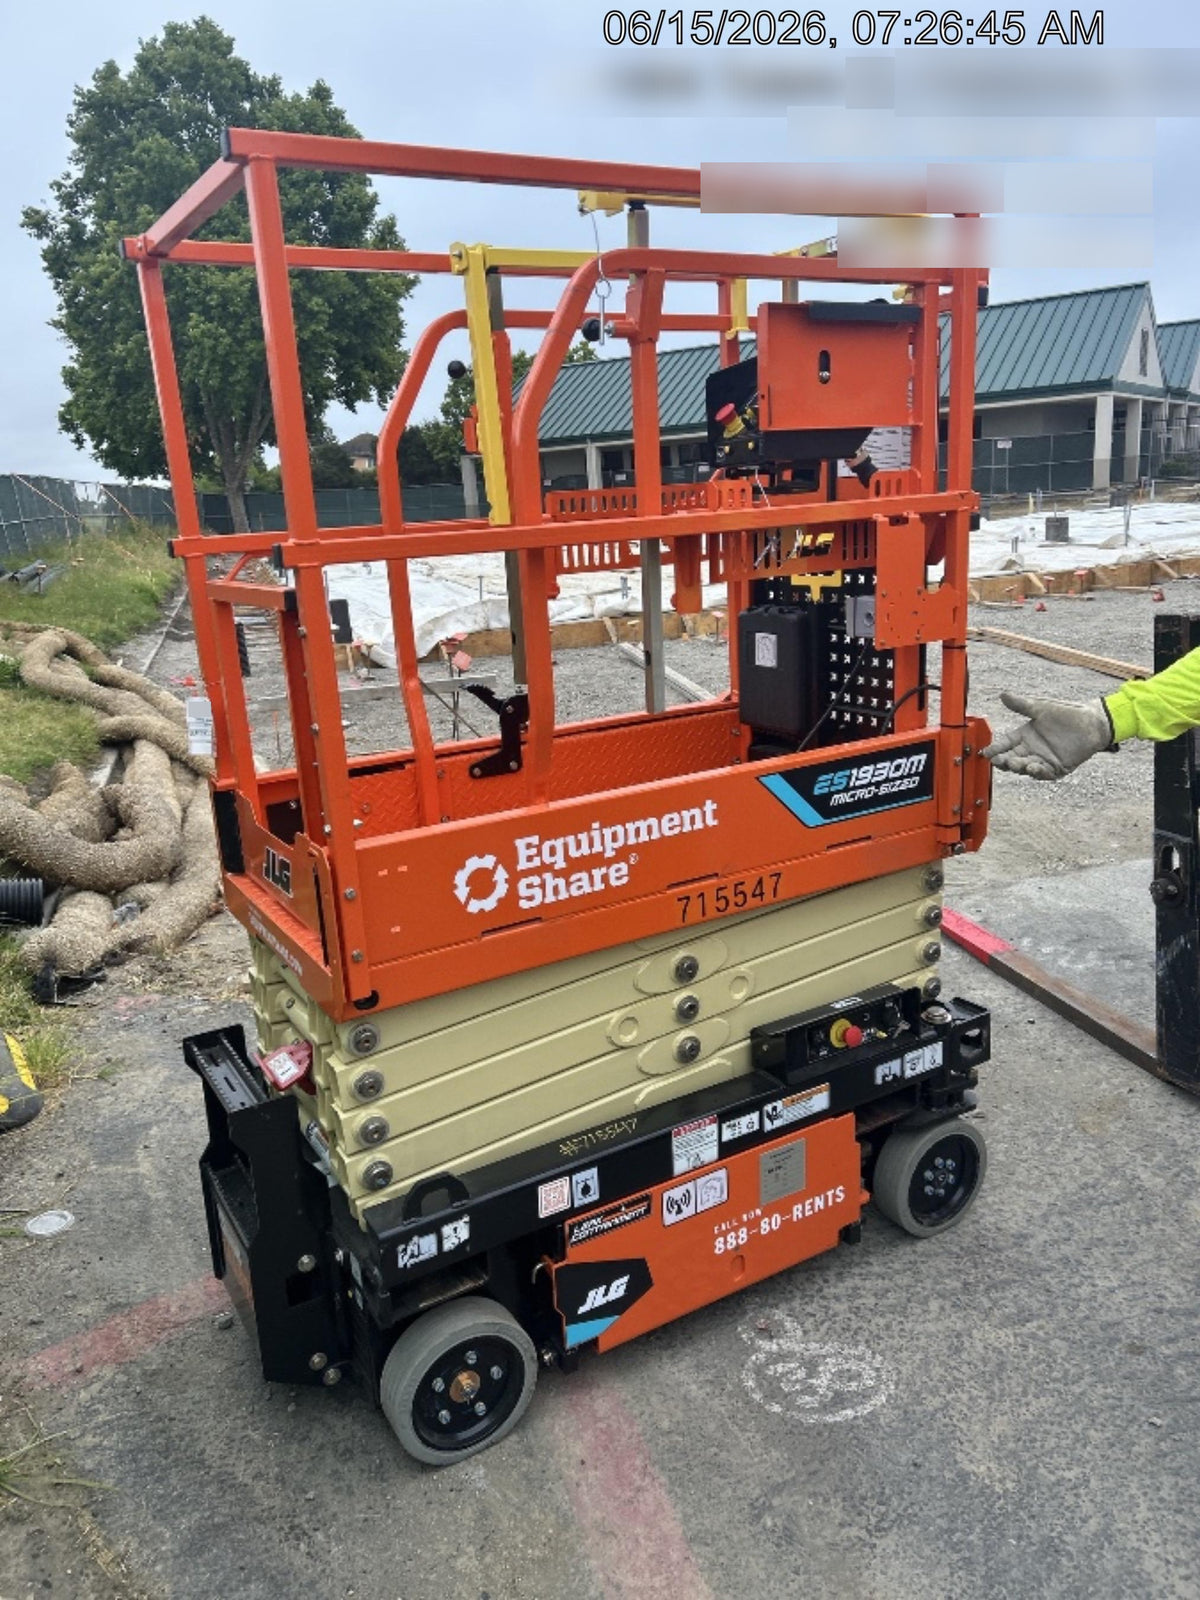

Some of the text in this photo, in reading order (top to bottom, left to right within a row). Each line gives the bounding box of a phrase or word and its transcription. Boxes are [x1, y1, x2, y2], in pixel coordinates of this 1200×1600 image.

[813, 753, 928, 795] ES1930M
[830, 776, 920, 806] MICRO-SIZED
[514, 799, 718, 870] Equipment
[264, 848, 293, 898] JLG
[677, 872, 782, 923] 715547
[714, 1185, 846, 1254] 888-80-RENTS
[577, 1274, 630, 1315] JLG
